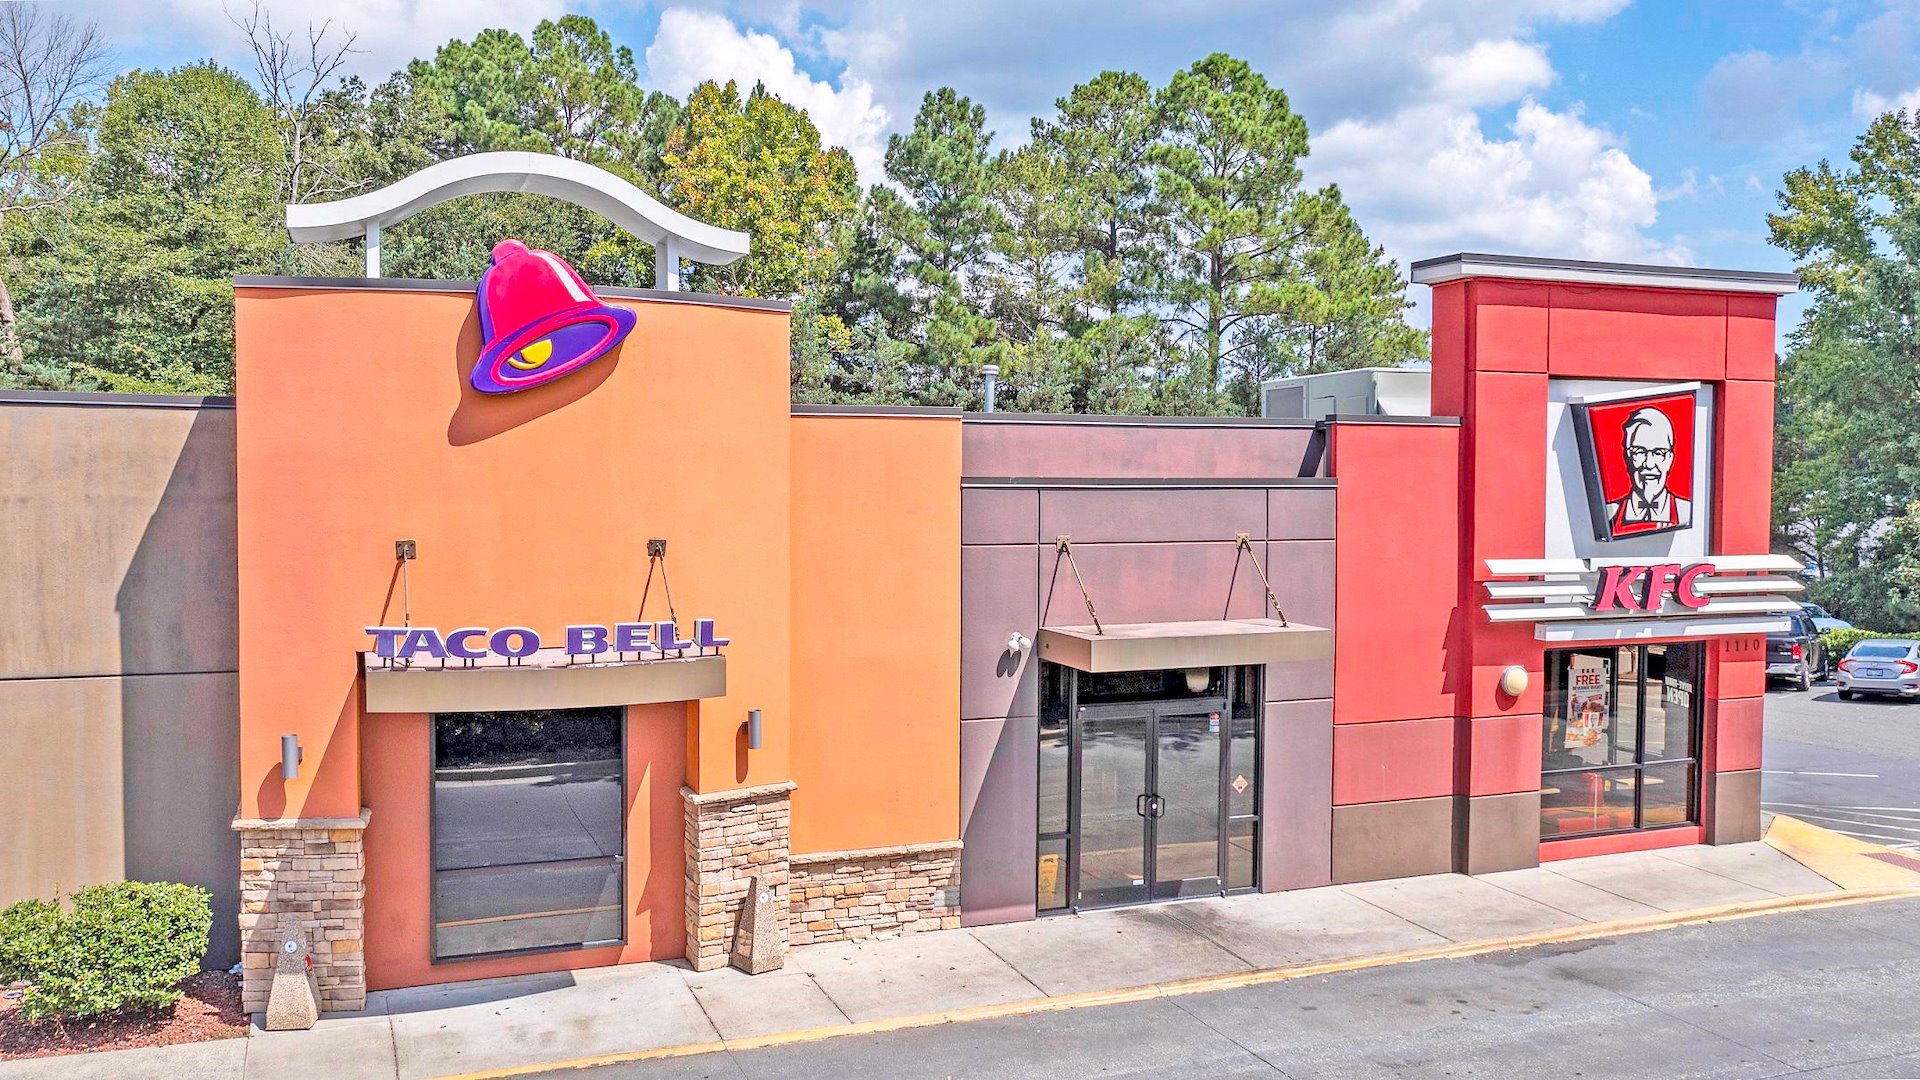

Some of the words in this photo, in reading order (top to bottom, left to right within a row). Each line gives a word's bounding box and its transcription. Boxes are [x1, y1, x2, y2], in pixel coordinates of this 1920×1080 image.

[1596, 563, 1715, 612] KFC
[364, 626, 542, 659] TACO
[565, 618, 731, 656] BELL
[1725, 639, 1760, 652] 1110
[1576, 674, 1601, 686] FREE
